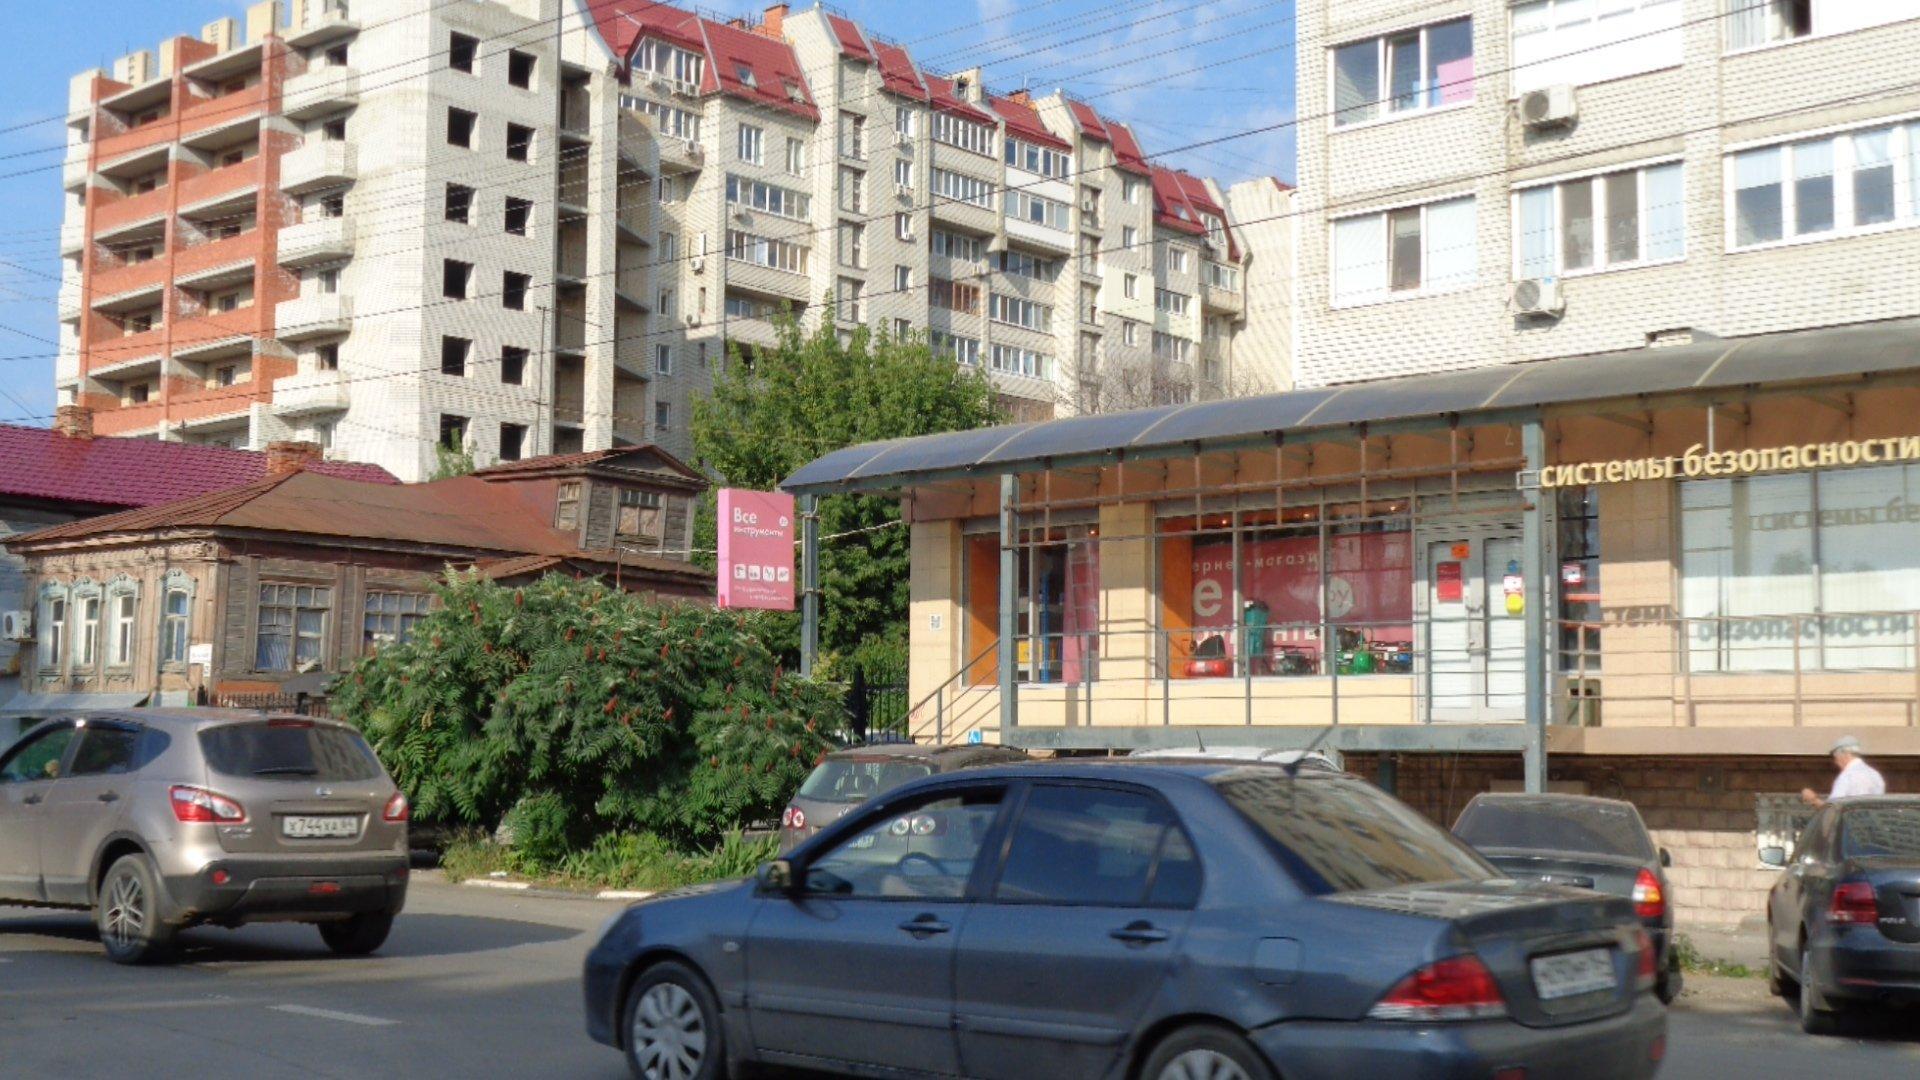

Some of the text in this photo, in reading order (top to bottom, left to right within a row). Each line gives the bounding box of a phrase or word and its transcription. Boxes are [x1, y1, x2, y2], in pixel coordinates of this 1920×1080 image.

[1540, 436, 1920, 488] системы безопасности
[734, 507, 757, 524] Все
